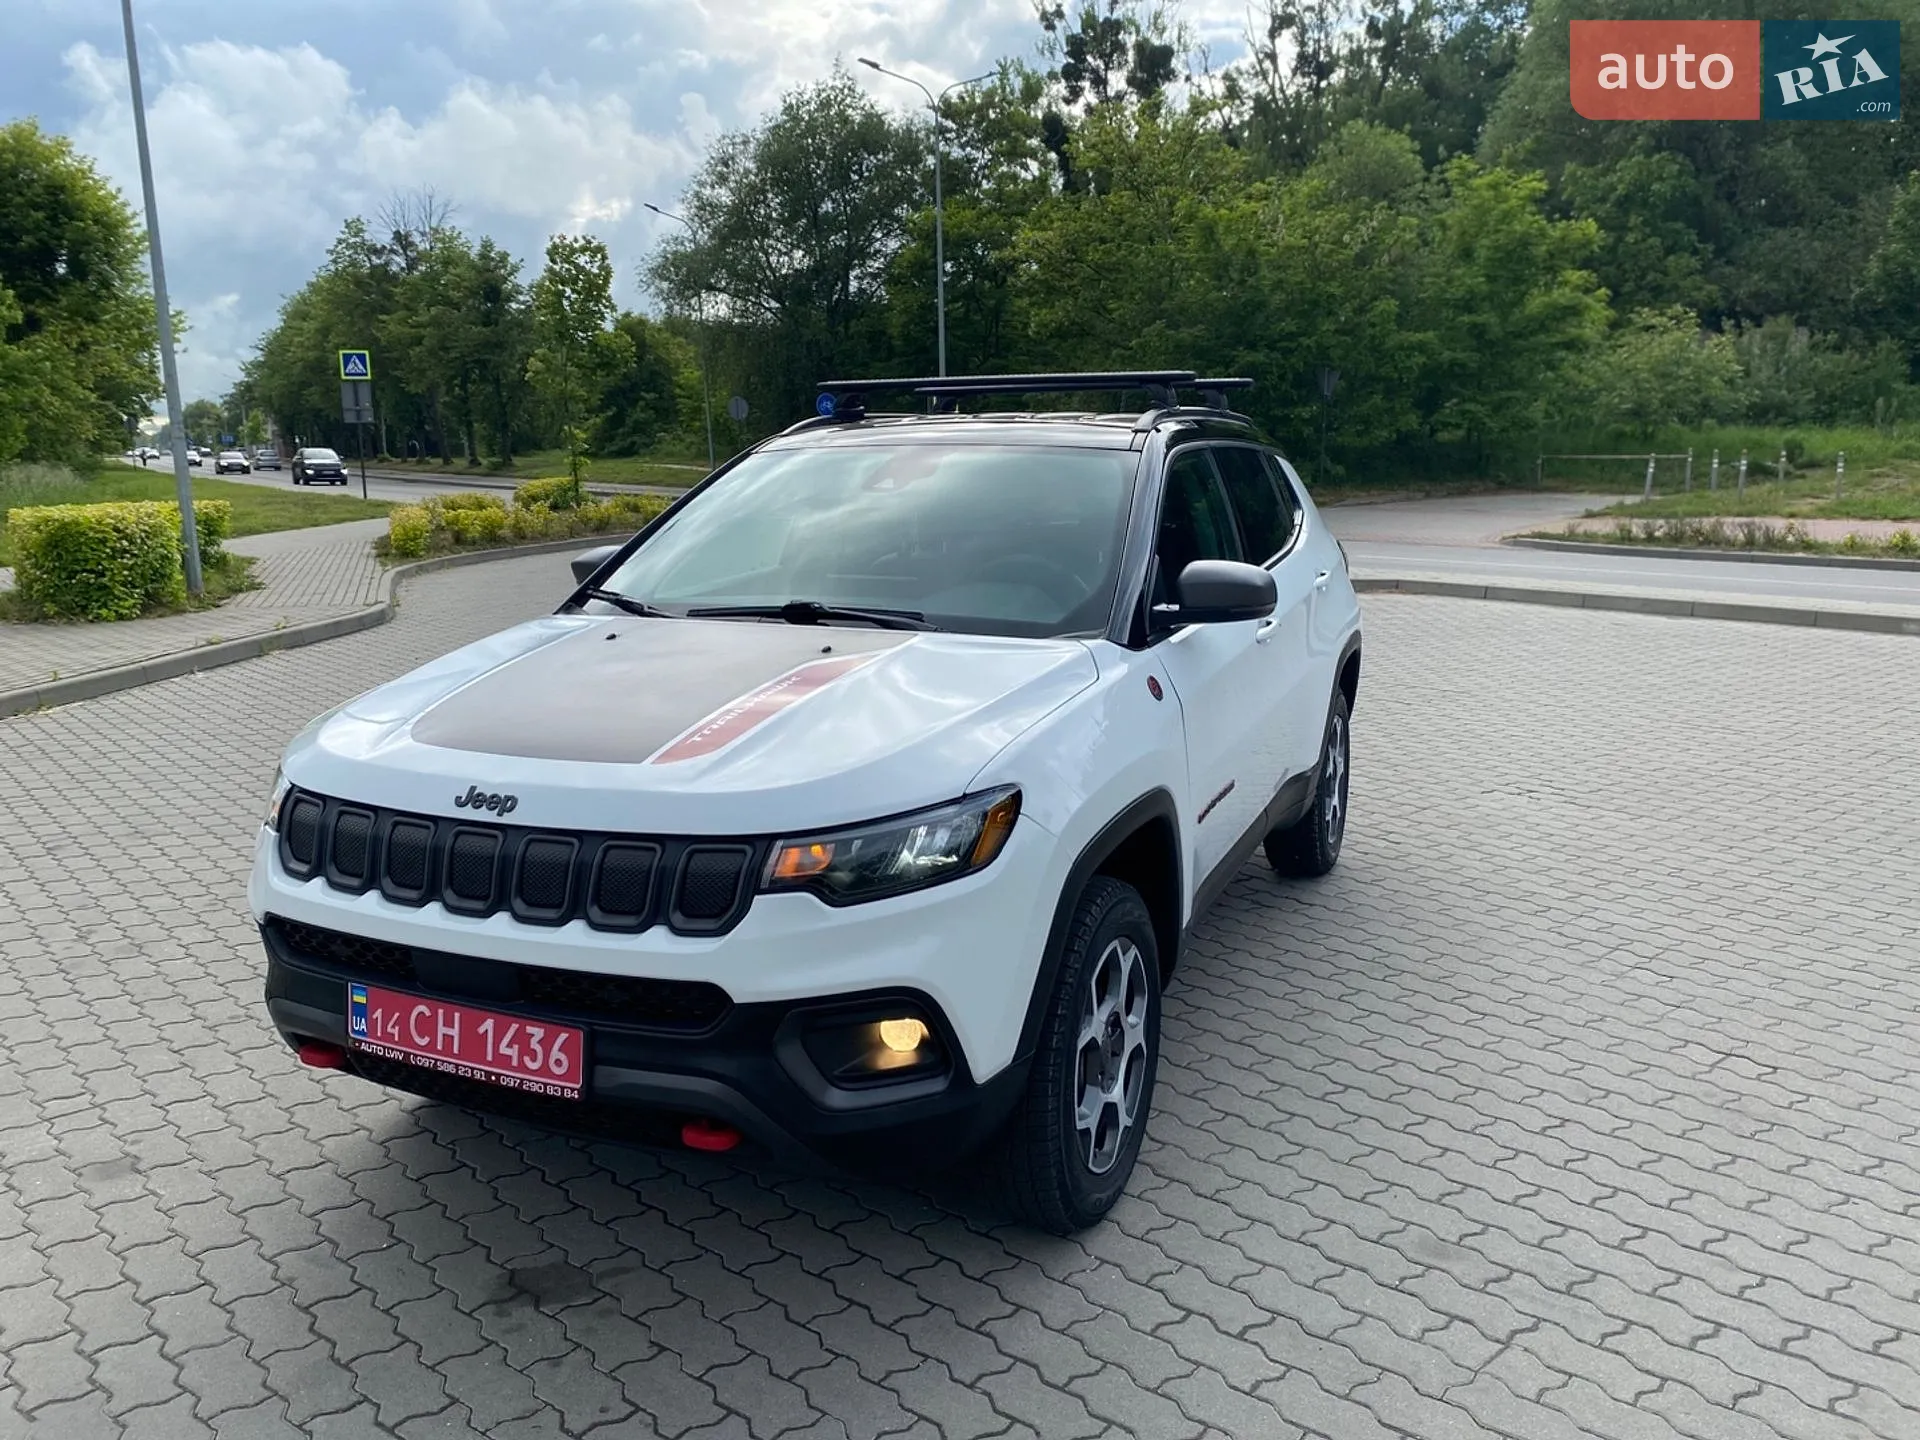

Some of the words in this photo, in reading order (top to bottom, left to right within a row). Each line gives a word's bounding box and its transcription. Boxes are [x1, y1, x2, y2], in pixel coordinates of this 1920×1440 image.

[454, 785, 519, 817] Jeep
[352, 1015, 367, 1033] UA
[372, 1008, 400, 1042] 14
[409, 1004, 461, 1055] CH
[477, 1018, 570, 1076] 1436
[360, 1042, 384, 1056] AUTO
[385, 1047, 404, 1061] LVIV
[500, 1075, 520, 1088] 097
